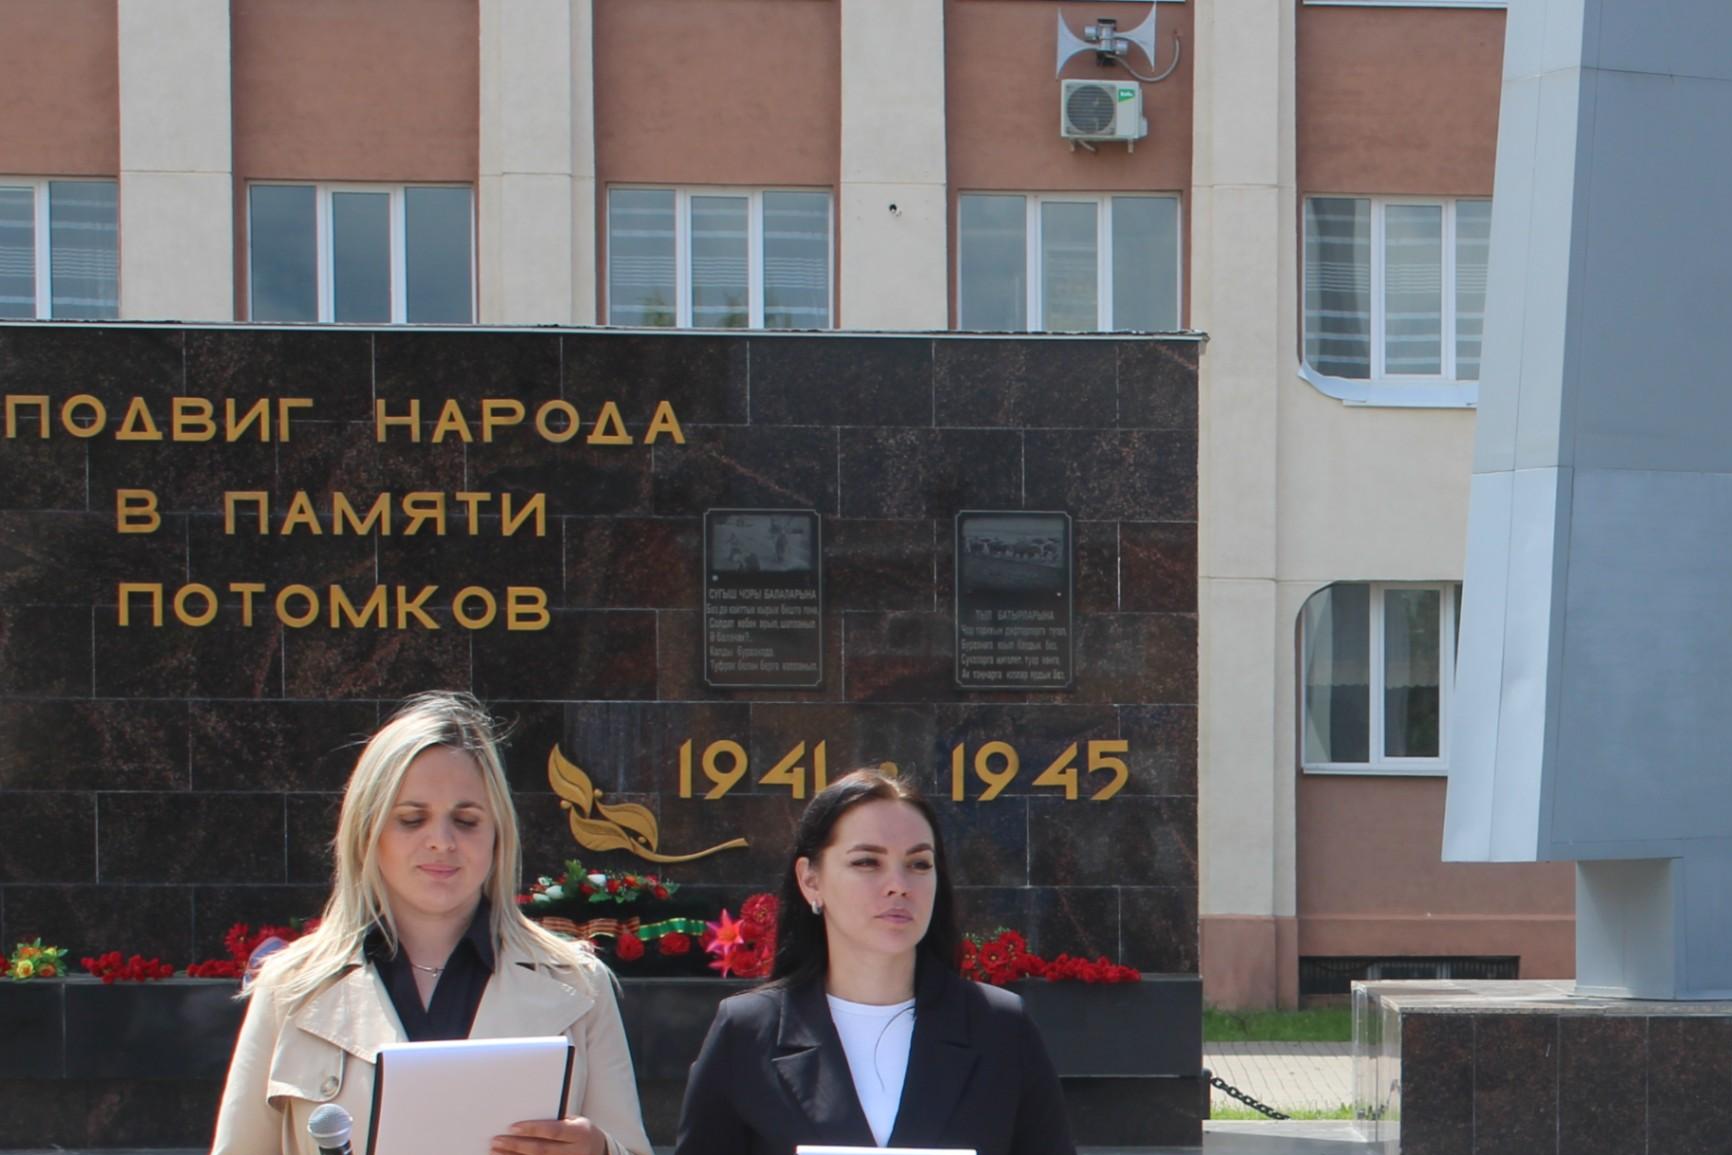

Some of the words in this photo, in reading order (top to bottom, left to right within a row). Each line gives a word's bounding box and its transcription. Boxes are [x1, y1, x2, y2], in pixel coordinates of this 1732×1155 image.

[5, 393, 312, 442] ПОДВИГ
[376, 398, 686, 446] НАРОДА
[117, 489, 161, 533] В
[224, 491, 546, 537] ПАМЯТИ
[118, 582, 551, 631] ПОТОМКОВ
[679, 738, 828, 800] 1941
[952, 739, 1130, 801] 1945
